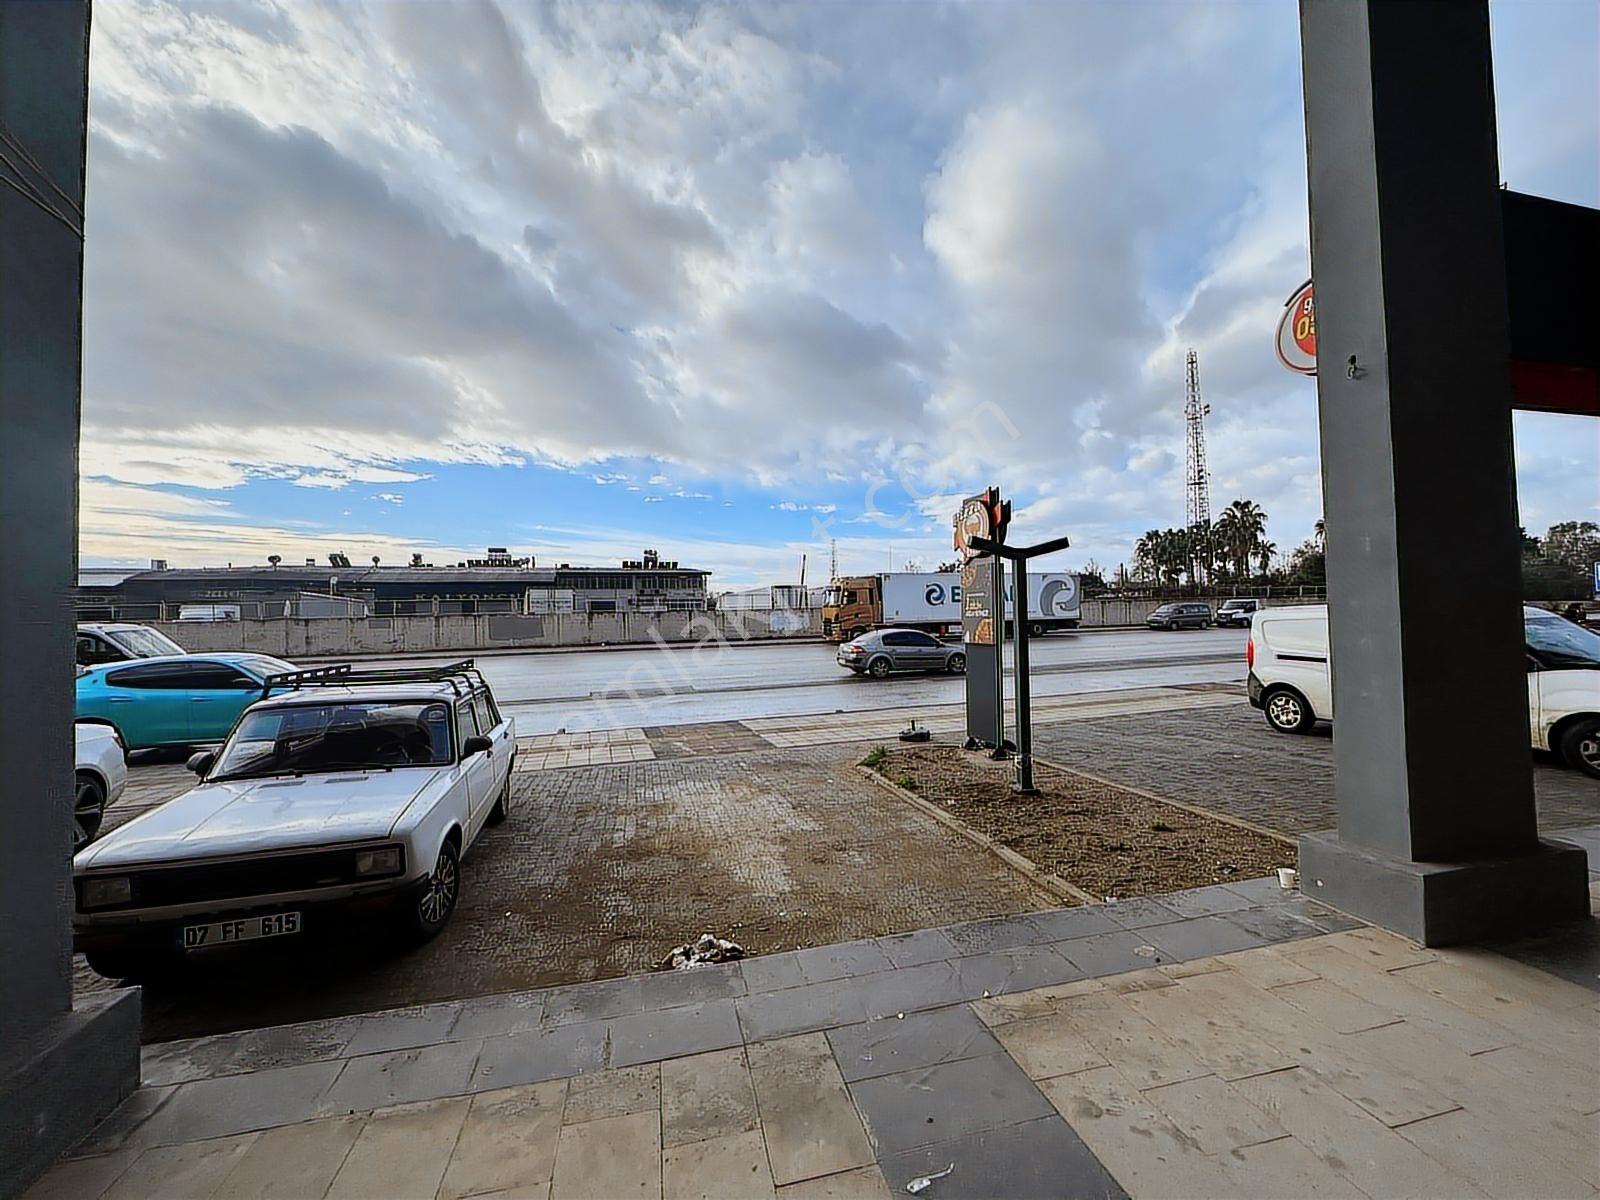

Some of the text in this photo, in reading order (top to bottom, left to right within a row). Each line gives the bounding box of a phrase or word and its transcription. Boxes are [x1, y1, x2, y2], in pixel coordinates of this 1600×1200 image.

[186, 912, 297, 946] 07 FF 615
